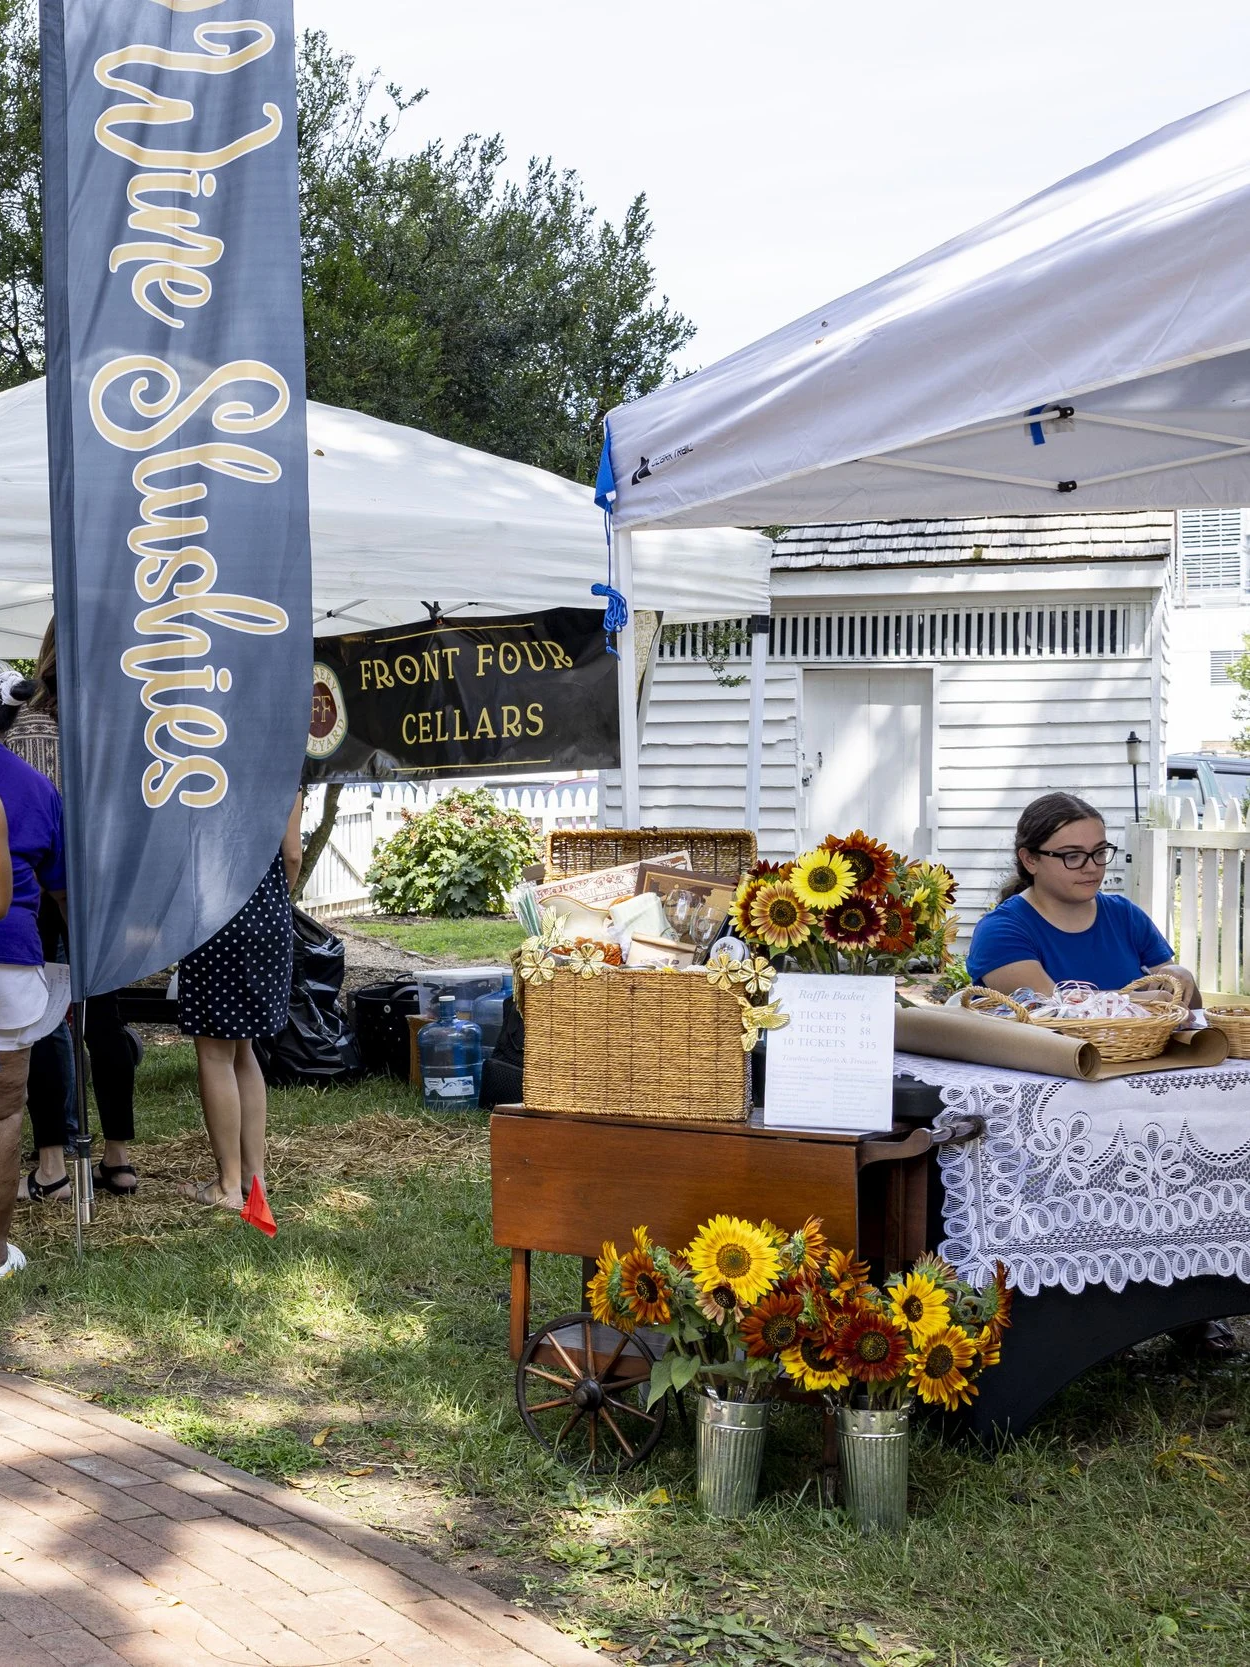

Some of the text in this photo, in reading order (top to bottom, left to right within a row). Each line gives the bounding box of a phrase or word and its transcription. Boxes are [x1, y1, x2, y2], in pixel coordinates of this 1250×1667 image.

[89, 20, 291, 809] Wine Slushies
[361, 640, 573, 690] FRONT FOUR
[313, 668, 338, 690] NERY
[402, 703, 544, 745] CELLARS
[310, 719, 345, 752] EYARD
[798, 989, 865, 1002] Raffle Basket
[798, 1010, 847, 1021] TICKETS
[798, 1024, 846, 1035] TICKETS
[798, 1037, 846, 1048] TICKETS
[858, 1040, 877, 1050] $15
